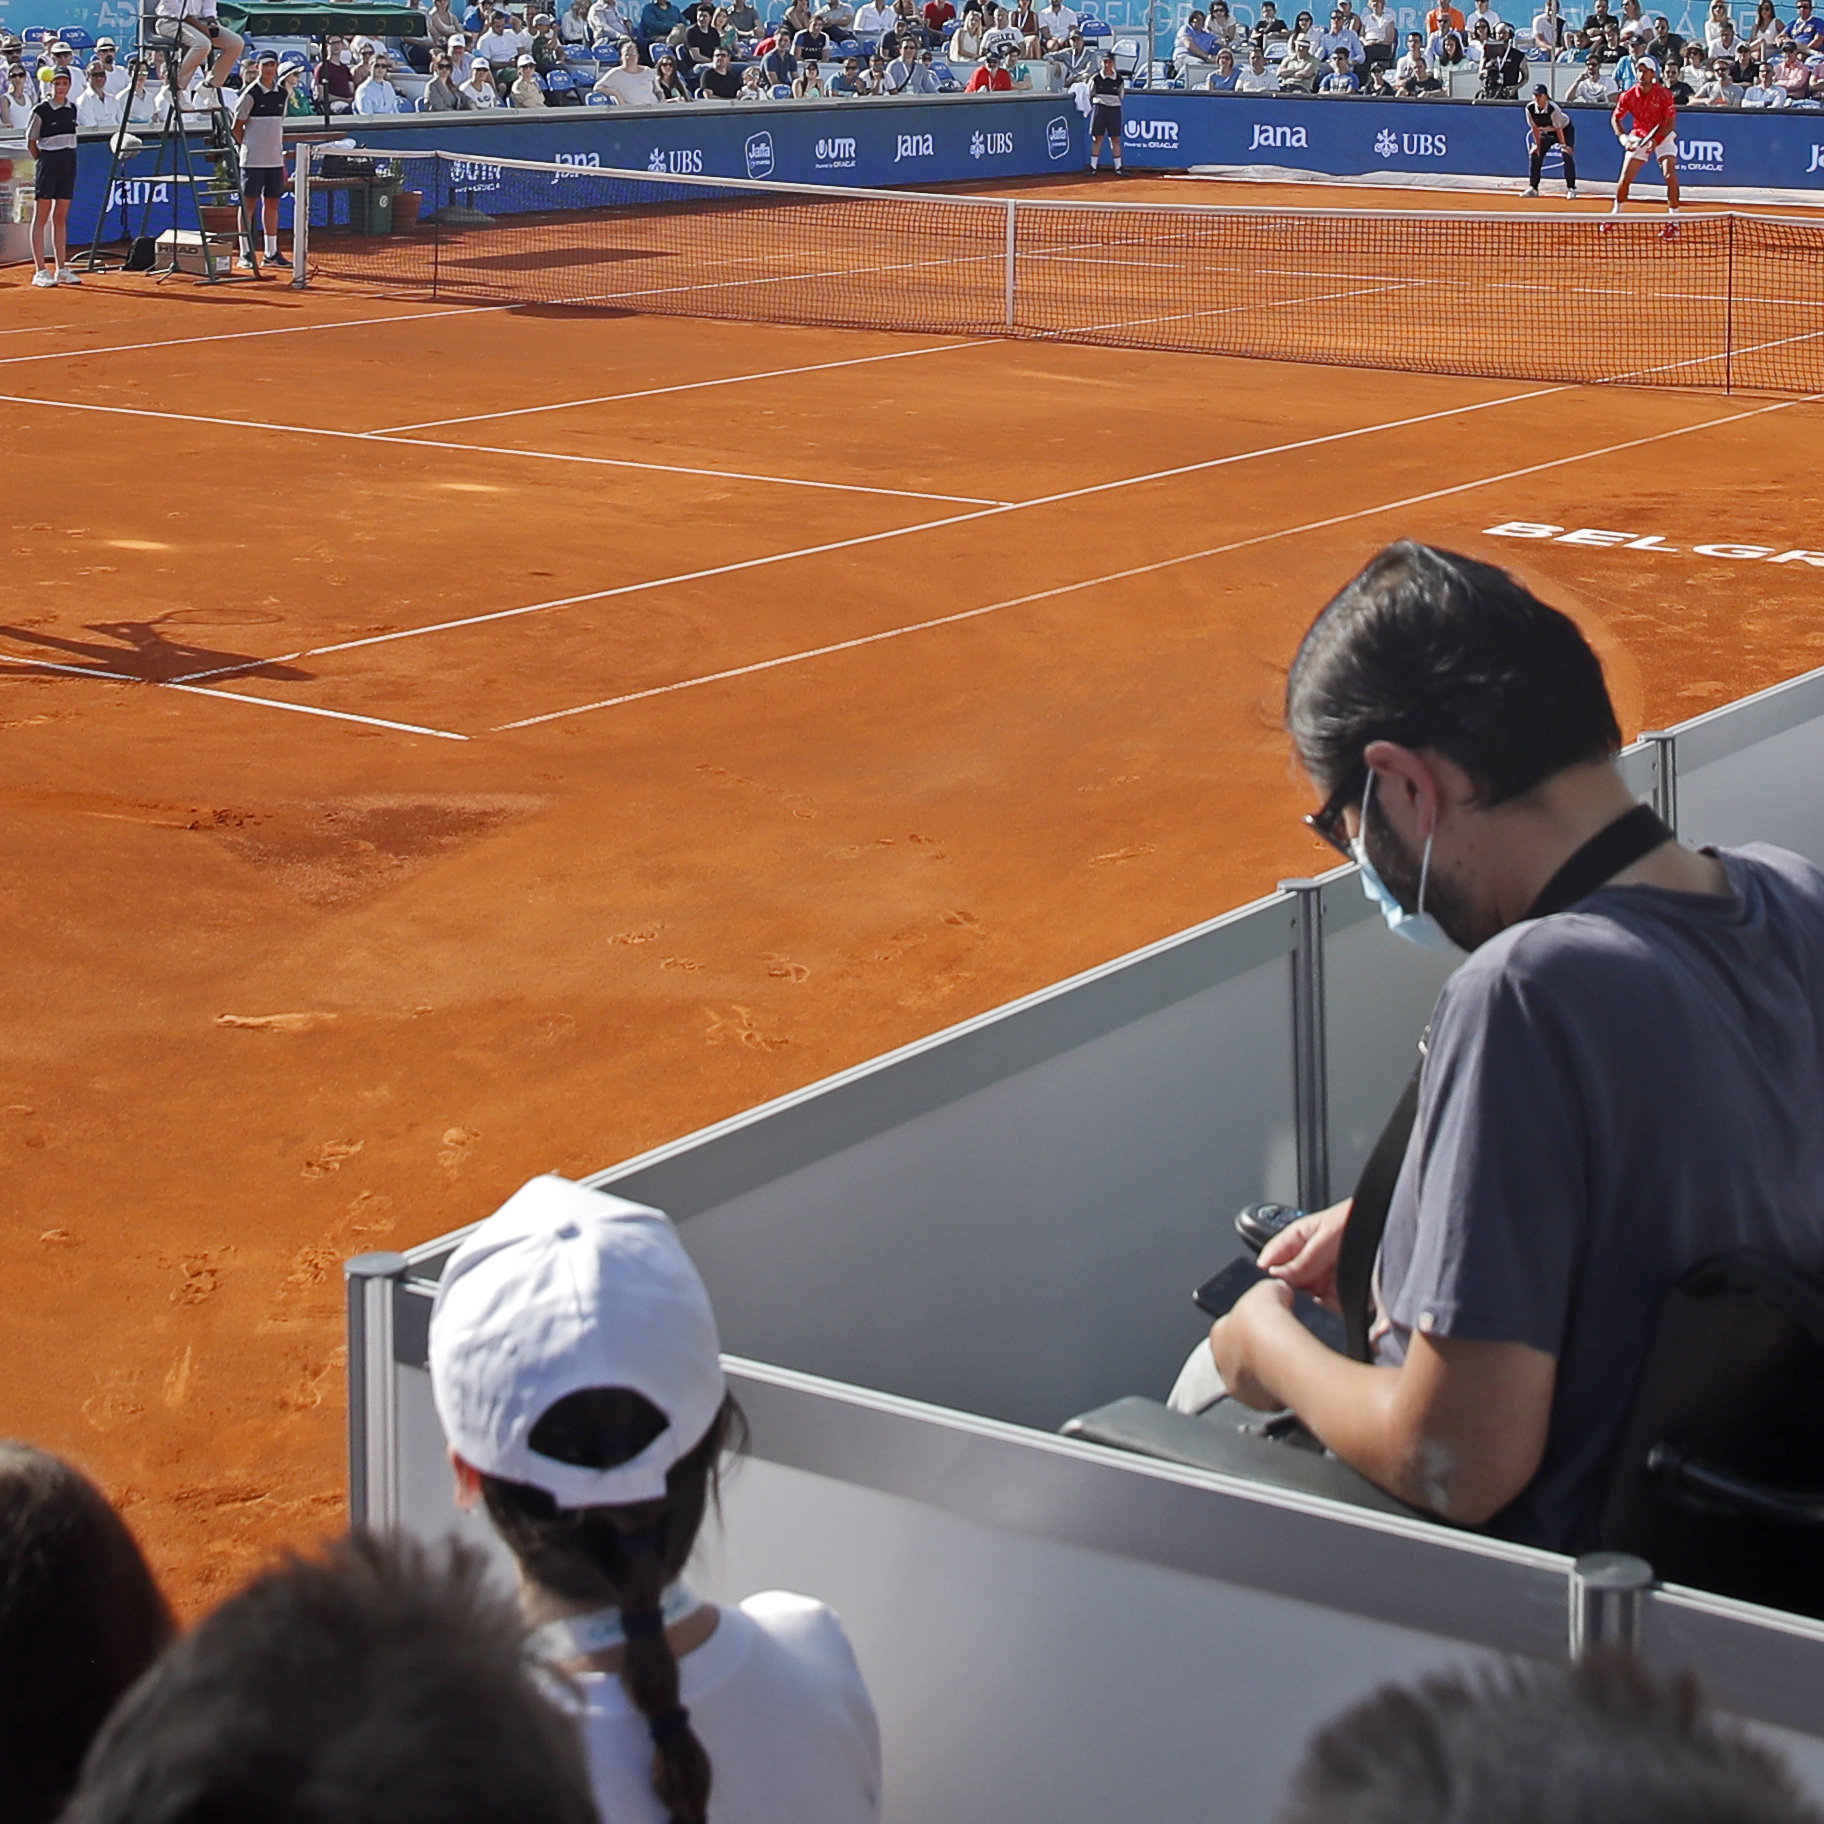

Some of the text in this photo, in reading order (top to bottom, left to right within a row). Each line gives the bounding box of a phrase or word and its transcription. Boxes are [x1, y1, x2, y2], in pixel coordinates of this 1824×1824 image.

[1141, 120, 1179, 141] UTR
[827, 137, 856, 159] UTR
[986, 132, 1013, 154] UBS
[1402, 133, 1447, 156] UBS
[1679, 140, 1724, 163] UTR
[669, 149, 703, 173] UBS
[158, 245, 200, 255] HEAD
